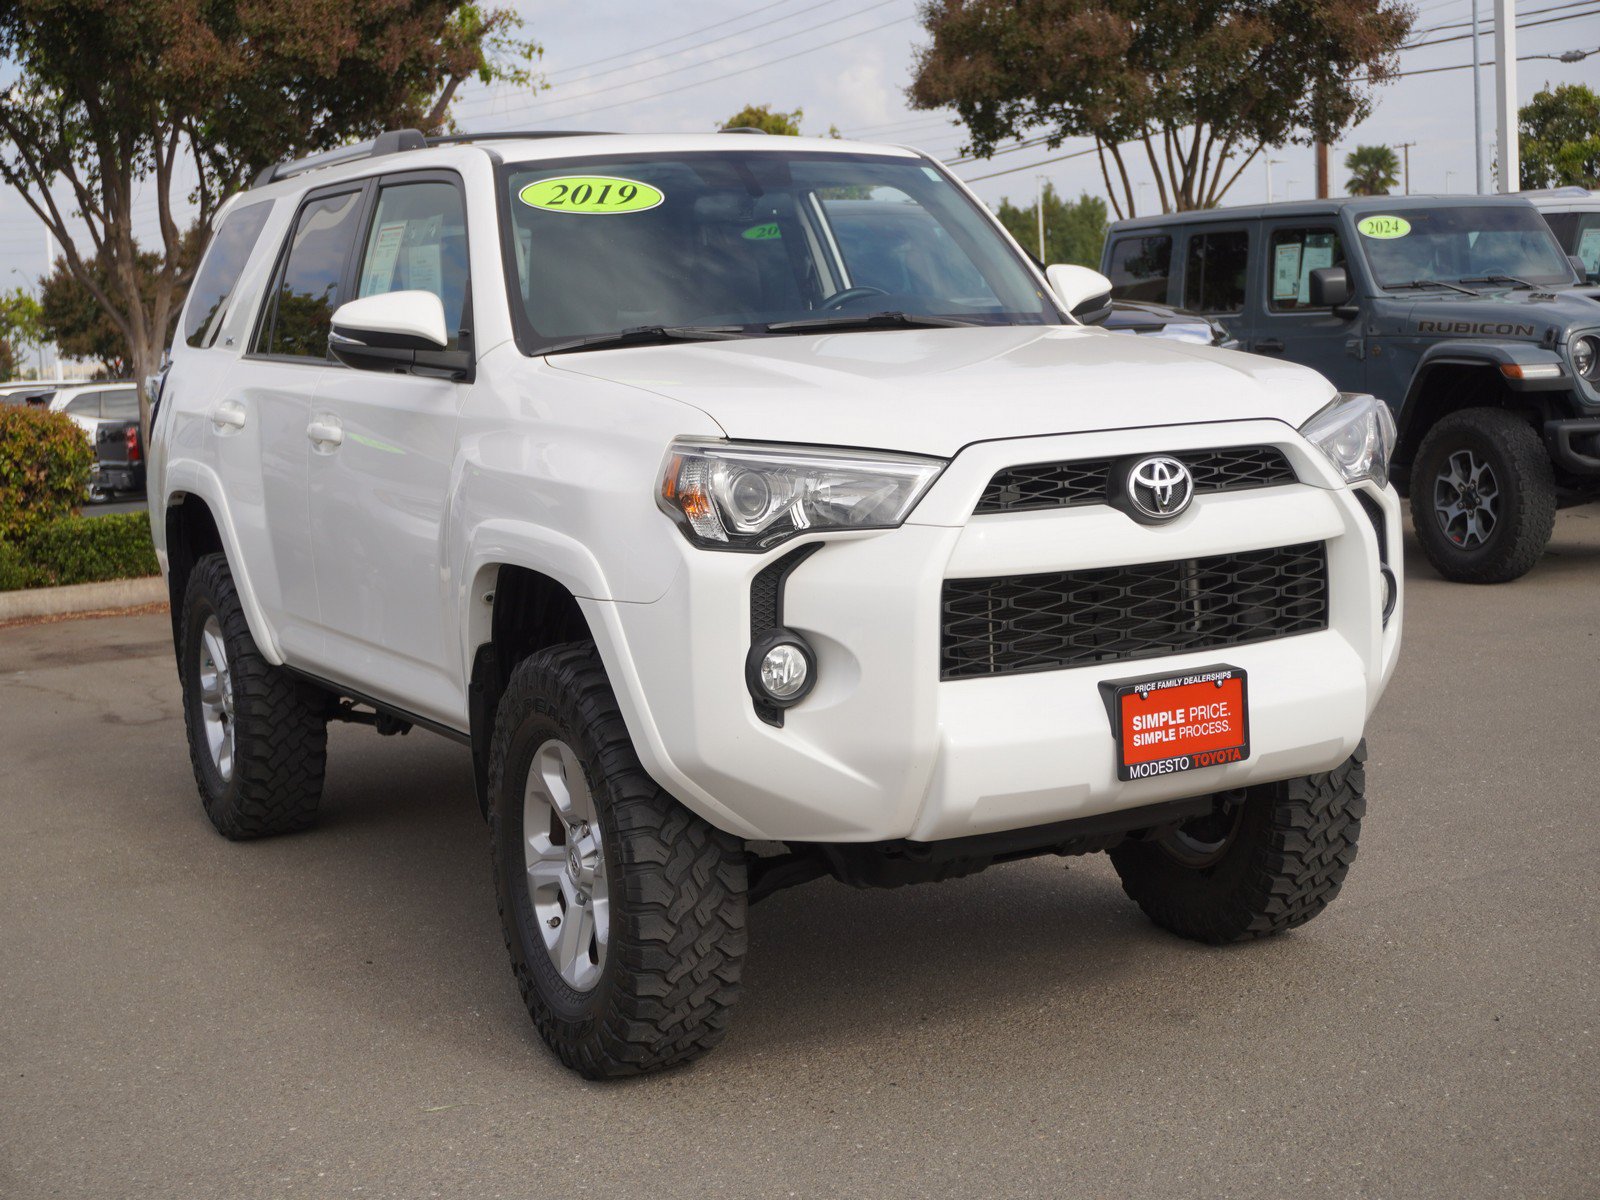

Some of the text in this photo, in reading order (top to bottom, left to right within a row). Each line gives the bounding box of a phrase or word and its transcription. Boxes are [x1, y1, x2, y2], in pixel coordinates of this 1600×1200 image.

[544, 183, 638, 206] 2019
[1367, 218, 1399, 235] 2024
[1417, 320, 1535, 337] RUBICON
[1134, 671, 1231, 693] PRICE FAMILY DEALERSHIPS
[1132, 701, 1231, 730] SIMPLE PRICE.
[1132, 719, 1231, 746] SIMPLE PROCESS.
[1129, 747, 1242, 779] MODESTO TOYOTA
